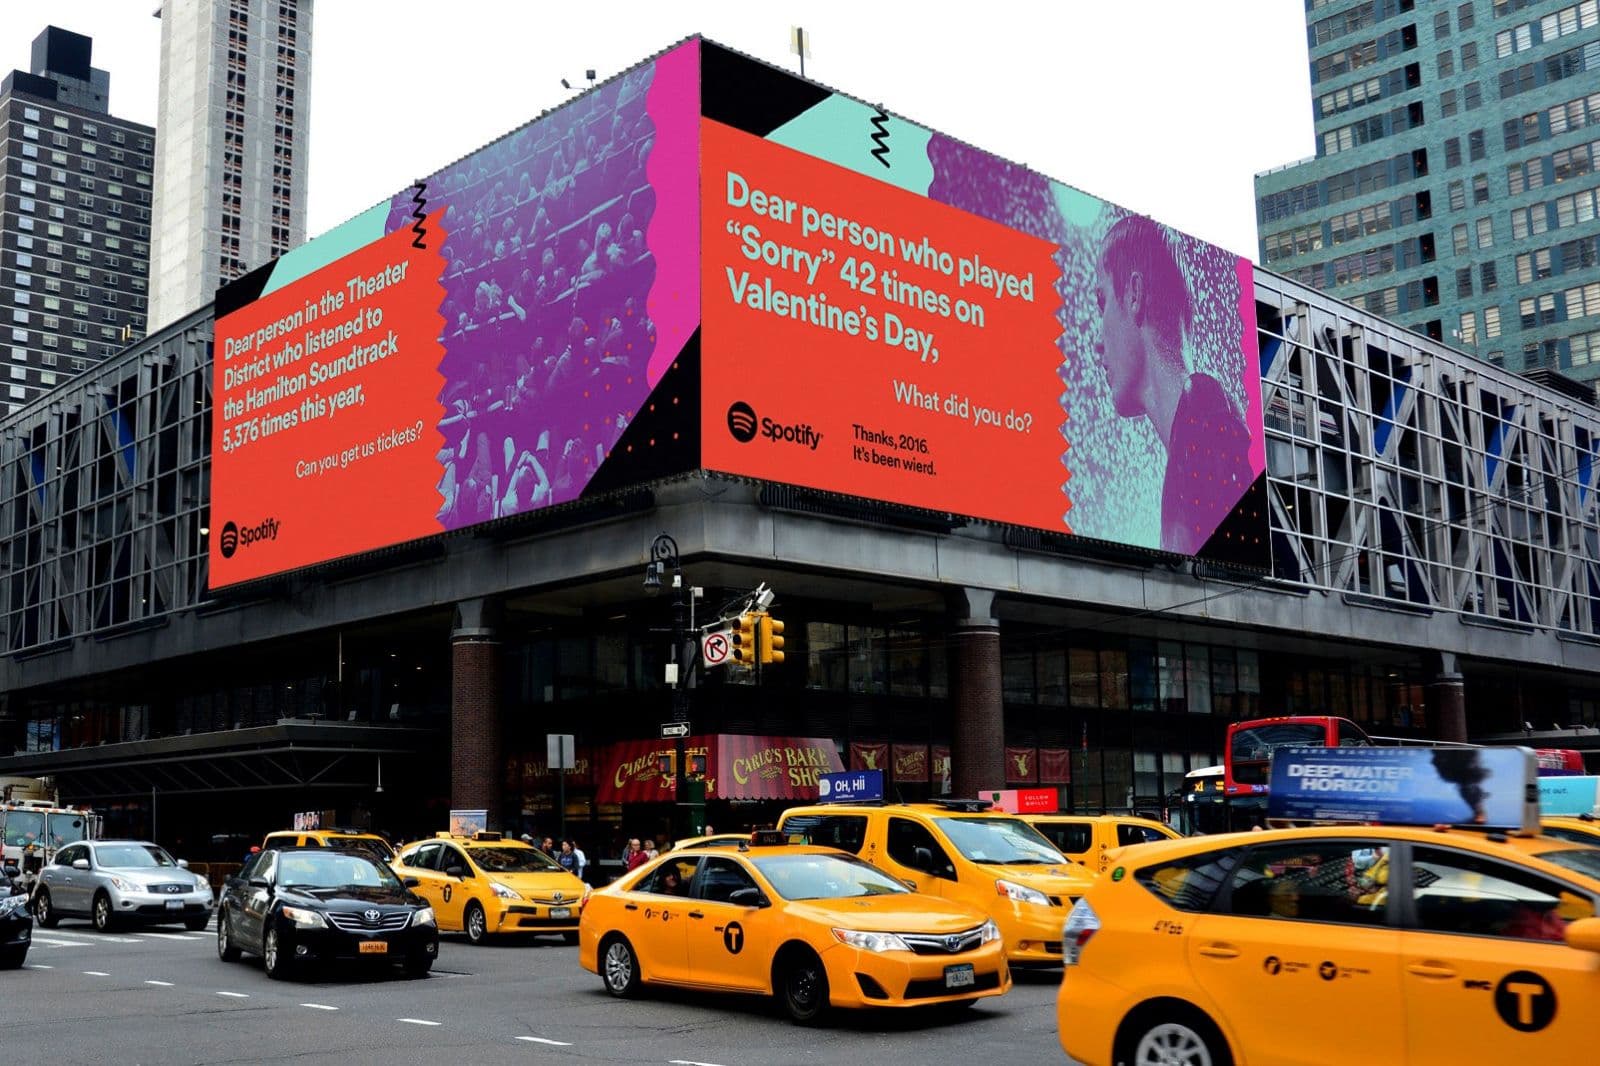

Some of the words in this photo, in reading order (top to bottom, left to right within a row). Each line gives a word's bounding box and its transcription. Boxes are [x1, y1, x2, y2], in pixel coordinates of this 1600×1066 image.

[727, 171, 797, 224] Dear
[802, 204, 894, 257] person
[899, 236, 954, 276] who
[958, 254, 1035, 302] played
[726, 219, 835, 286] “Sorry”
[840, 256, 877, 296] 42
[881, 270, 951, 319] times
[955, 302, 985, 328] on
[224, 332, 255, 361] Dear
[256, 310, 303, 352] person
[305, 300, 318, 324] in
[320, 289, 345, 317] the
[347, 259, 410, 304] Theater
[725, 266, 879, 342] Valentine’s
[884, 311, 940, 364] Day,
[224, 353, 271, 391] District
[273, 342, 304, 369] who
[305, 310, 363, 357] listened
[366, 307, 383, 328] to
[223, 397, 244, 421] the
[246, 371, 307, 414] Hamilton
[309, 330, 399, 388] Soundtrack
[222, 418, 259, 453] 5,376
[260, 408, 299, 439] times
[300, 393, 326, 422] this
[328, 383, 365, 418] year,
[893, 378, 940, 413] What
[943, 393, 969, 419] did
[972, 405, 1002, 427] you
[1005, 408, 1033, 434] do?
[295, 459, 317, 479] Can
[319, 454, 339, 475] you
[340, 447, 360, 468] get
[362, 441, 375, 458] us
[377, 420, 424, 453] tickets?
[761, 417, 821, 451] Spotify
[852, 423, 899, 452] Thanks,
[899, 434, 931, 455] 2016.
[853, 445, 870, 462] It's
[872, 449, 901, 469] been
[903, 456, 937, 476] wierd.
[240, 517, 280, 548] Spotify
[733, 747, 783, 785] CARLO'S
[784, 747, 830, 767] BAKE
[787, 766, 833, 787] SHO
[835, 780, 851, 793] OH,
[1287, 764, 1414, 780] DEEPWATER
[1301, 777, 1399, 793] HORIZON
